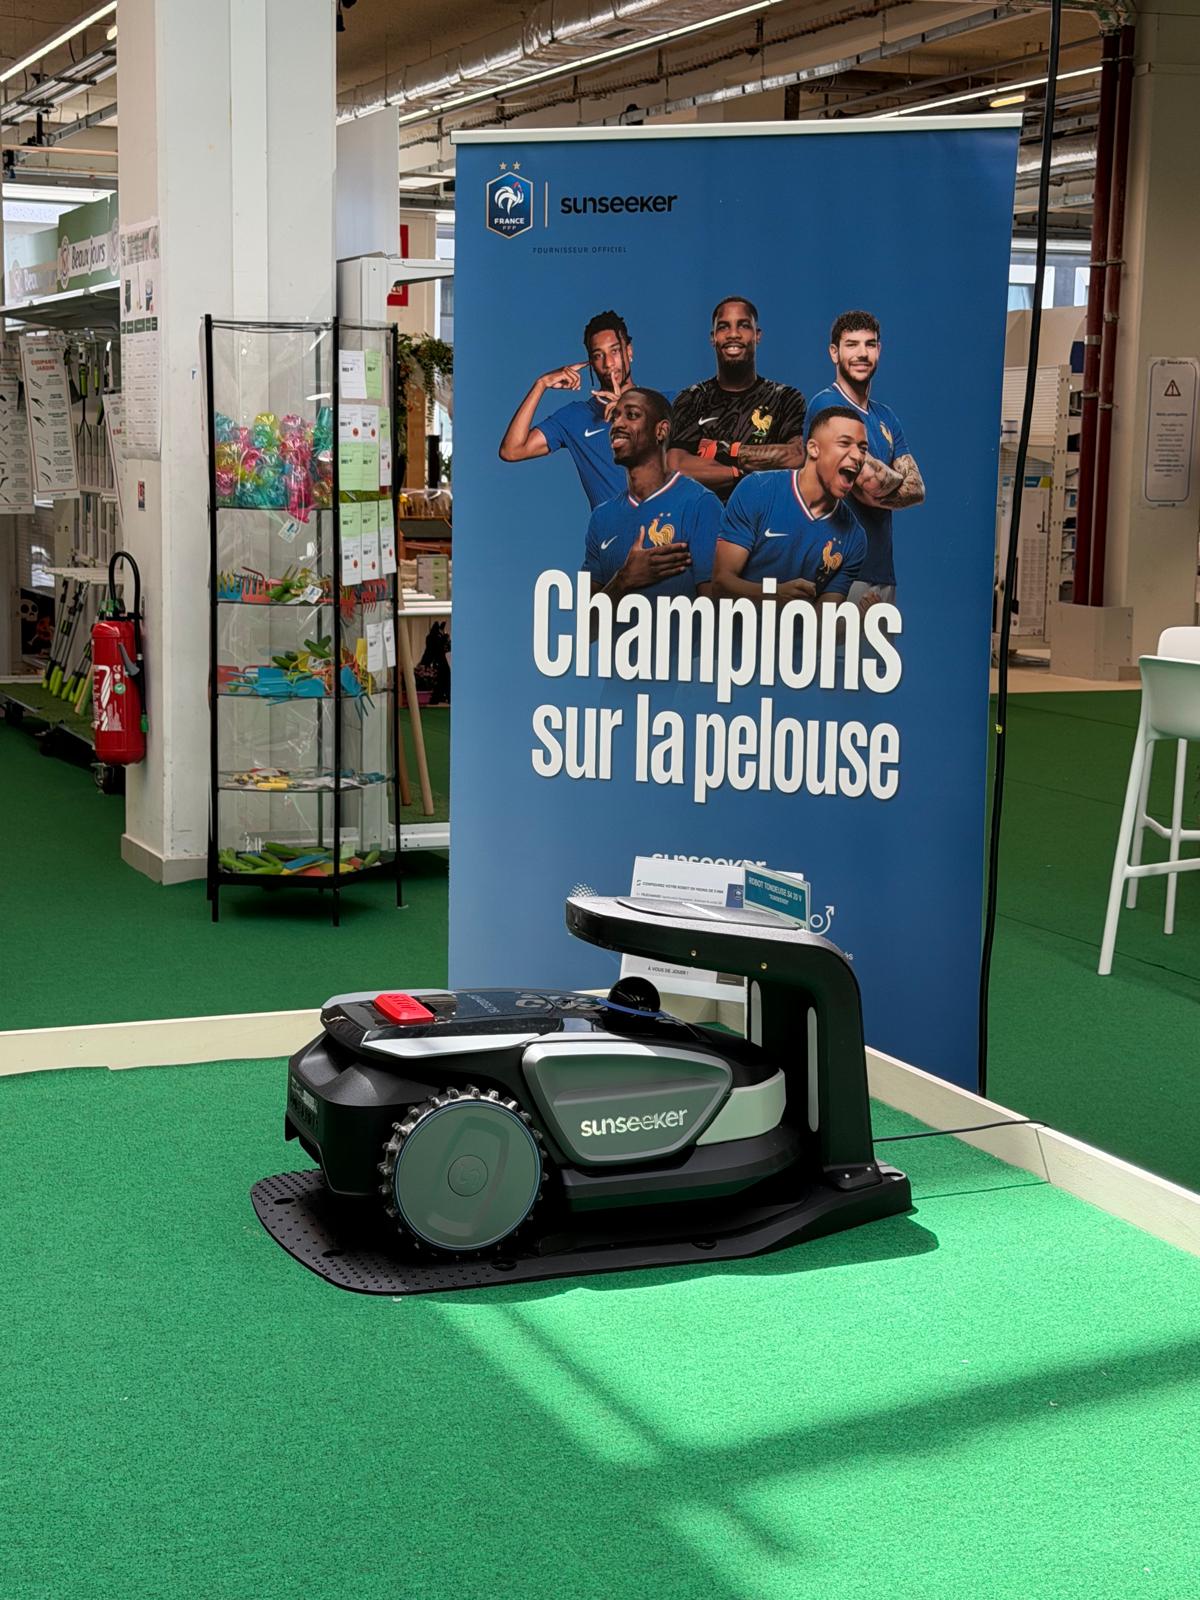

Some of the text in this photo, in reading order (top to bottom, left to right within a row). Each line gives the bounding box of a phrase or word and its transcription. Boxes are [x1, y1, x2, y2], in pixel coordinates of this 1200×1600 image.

[560, 195, 678, 214] sunseeker
[494, 217, 524, 225] FRANCE
[71, 245, 88, 270] Beaux
[88, 240, 106, 271] jours
[532, 246, 627, 254] FOURNISSEUR OFFICIEL
[533, 569, 903, 702] Champions
[530, 694, 900, 803] sur la pelouse
[748, 876, 764, 889] ROBOT
[580, 1109, 688, 1137] sunseeker
